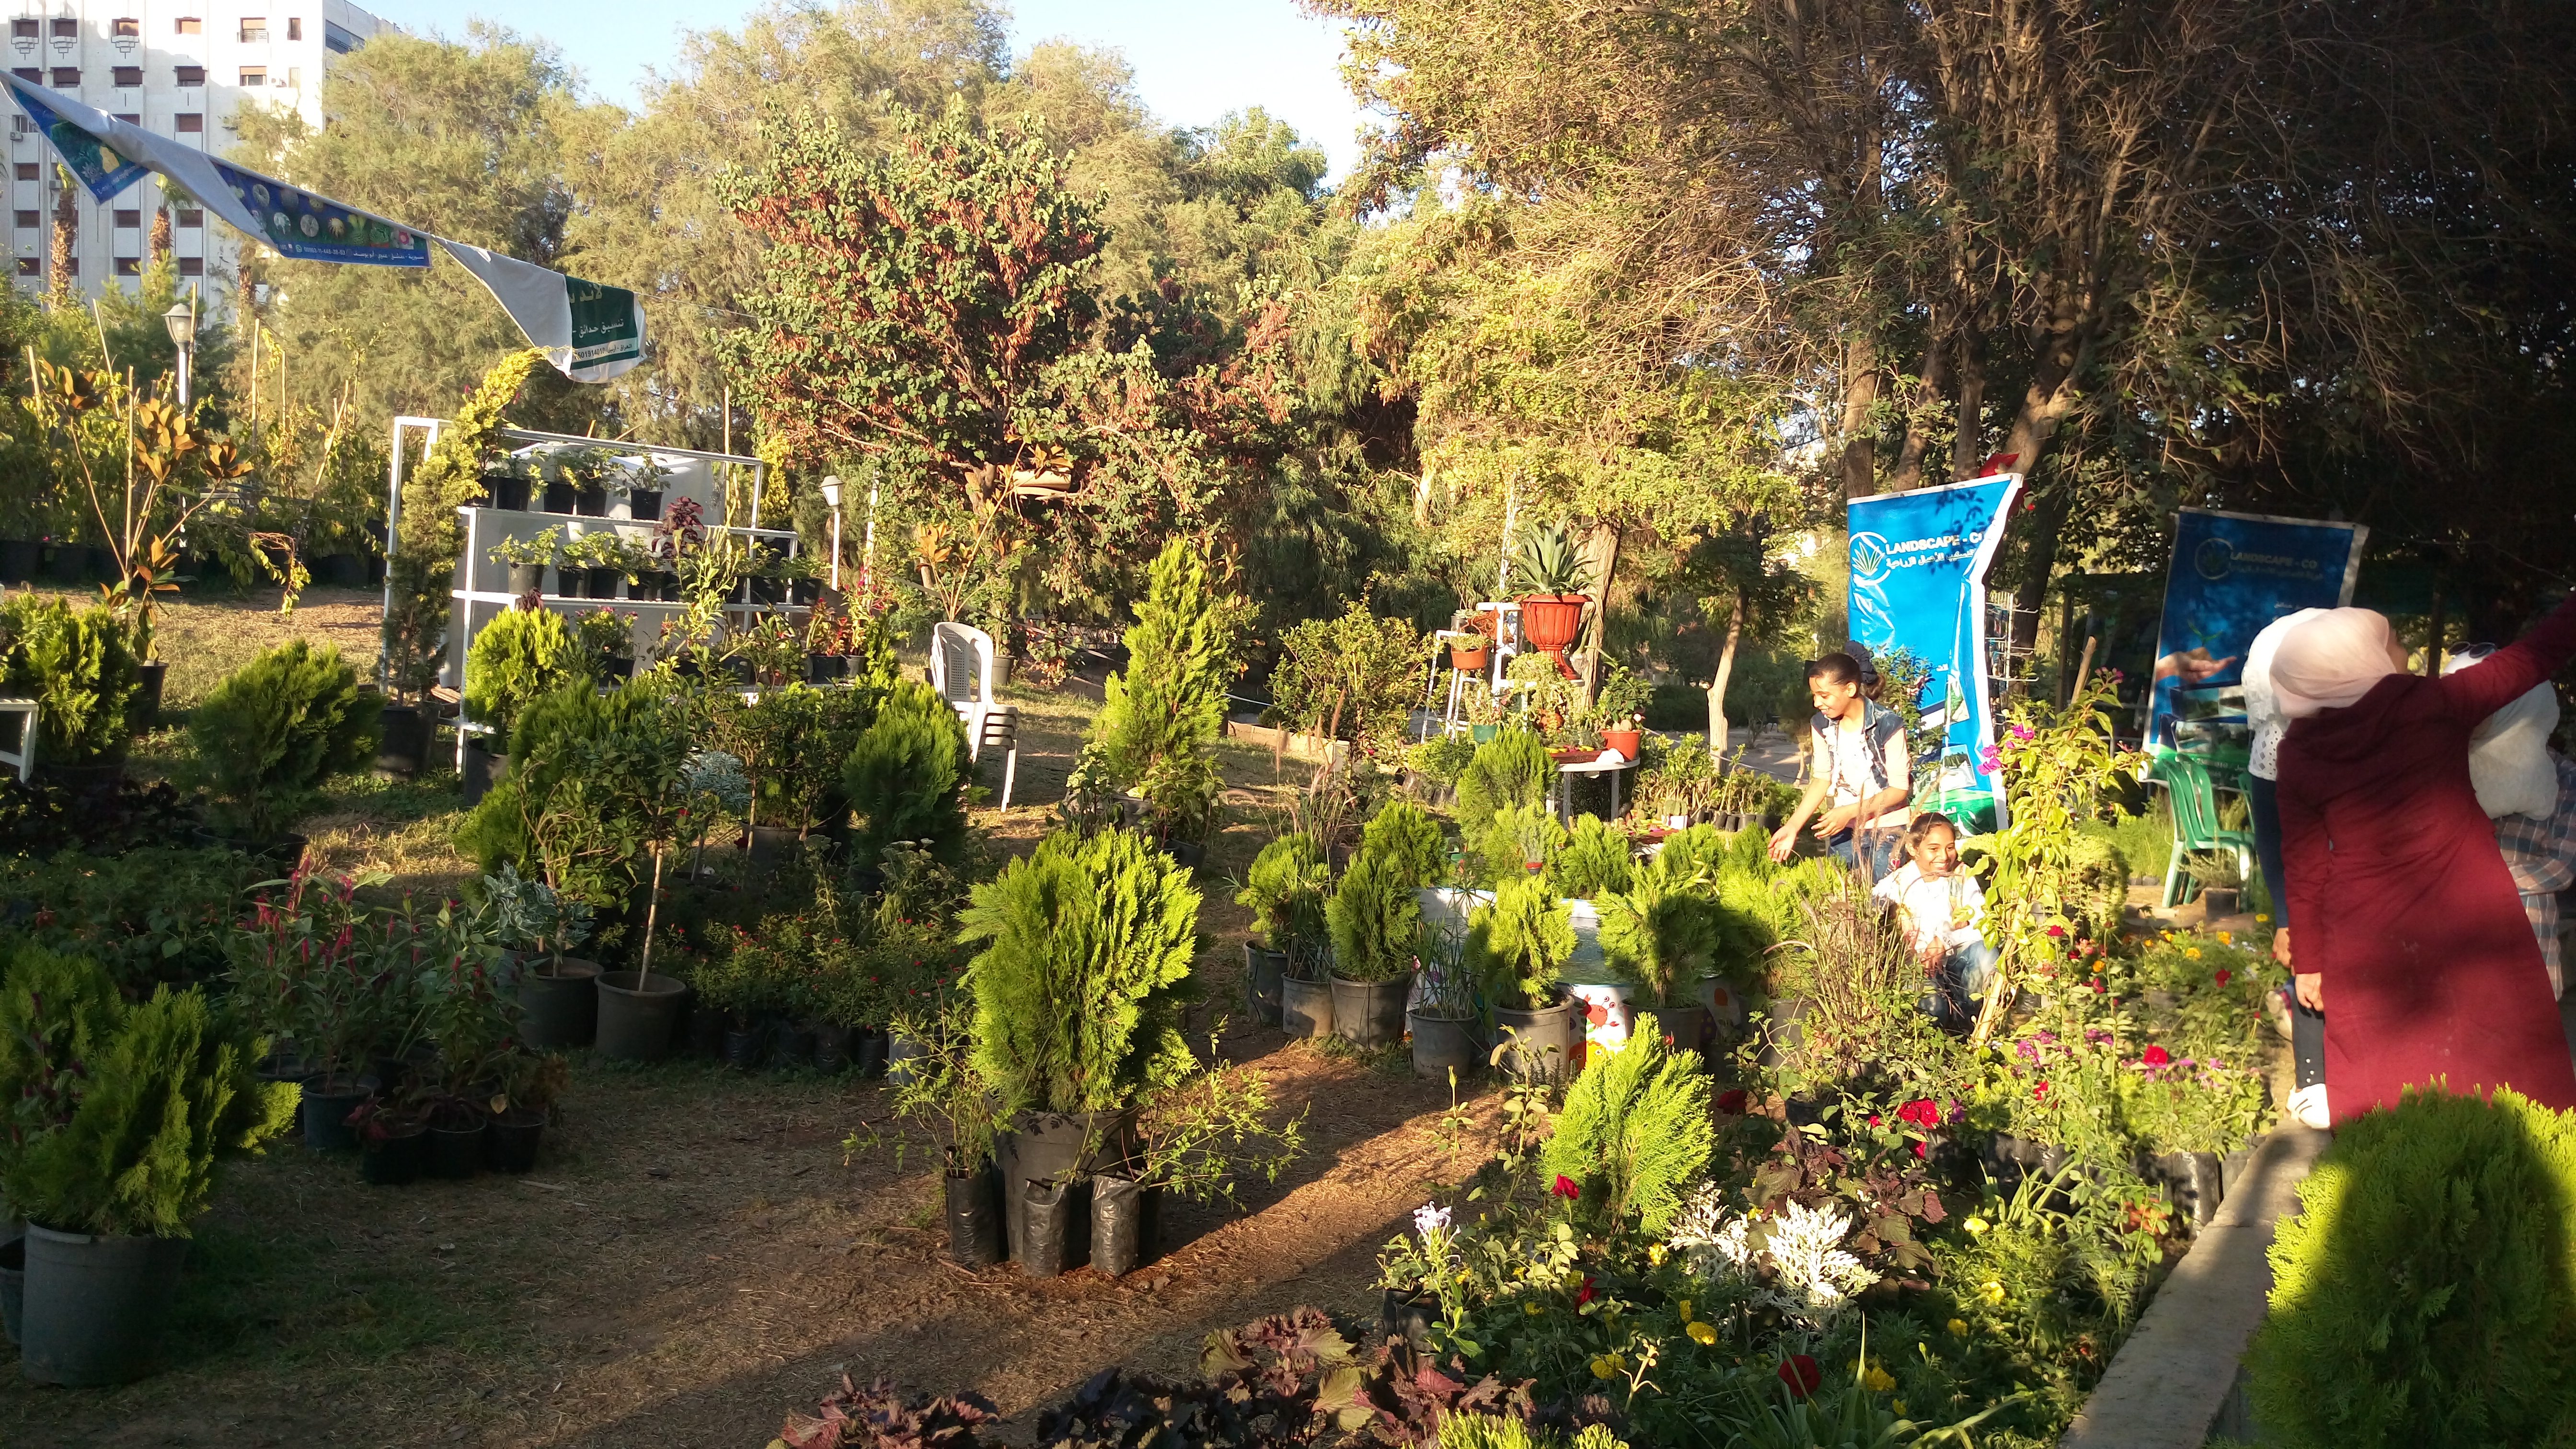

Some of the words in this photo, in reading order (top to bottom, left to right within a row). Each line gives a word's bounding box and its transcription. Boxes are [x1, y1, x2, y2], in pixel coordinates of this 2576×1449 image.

[579, 324, 599, 338] حدائق
[601, 318, 624, 334] تنسيق
[620, 343, 632, 352] العراق
[1885, 534, 1960, 555] LANDSCAPE
